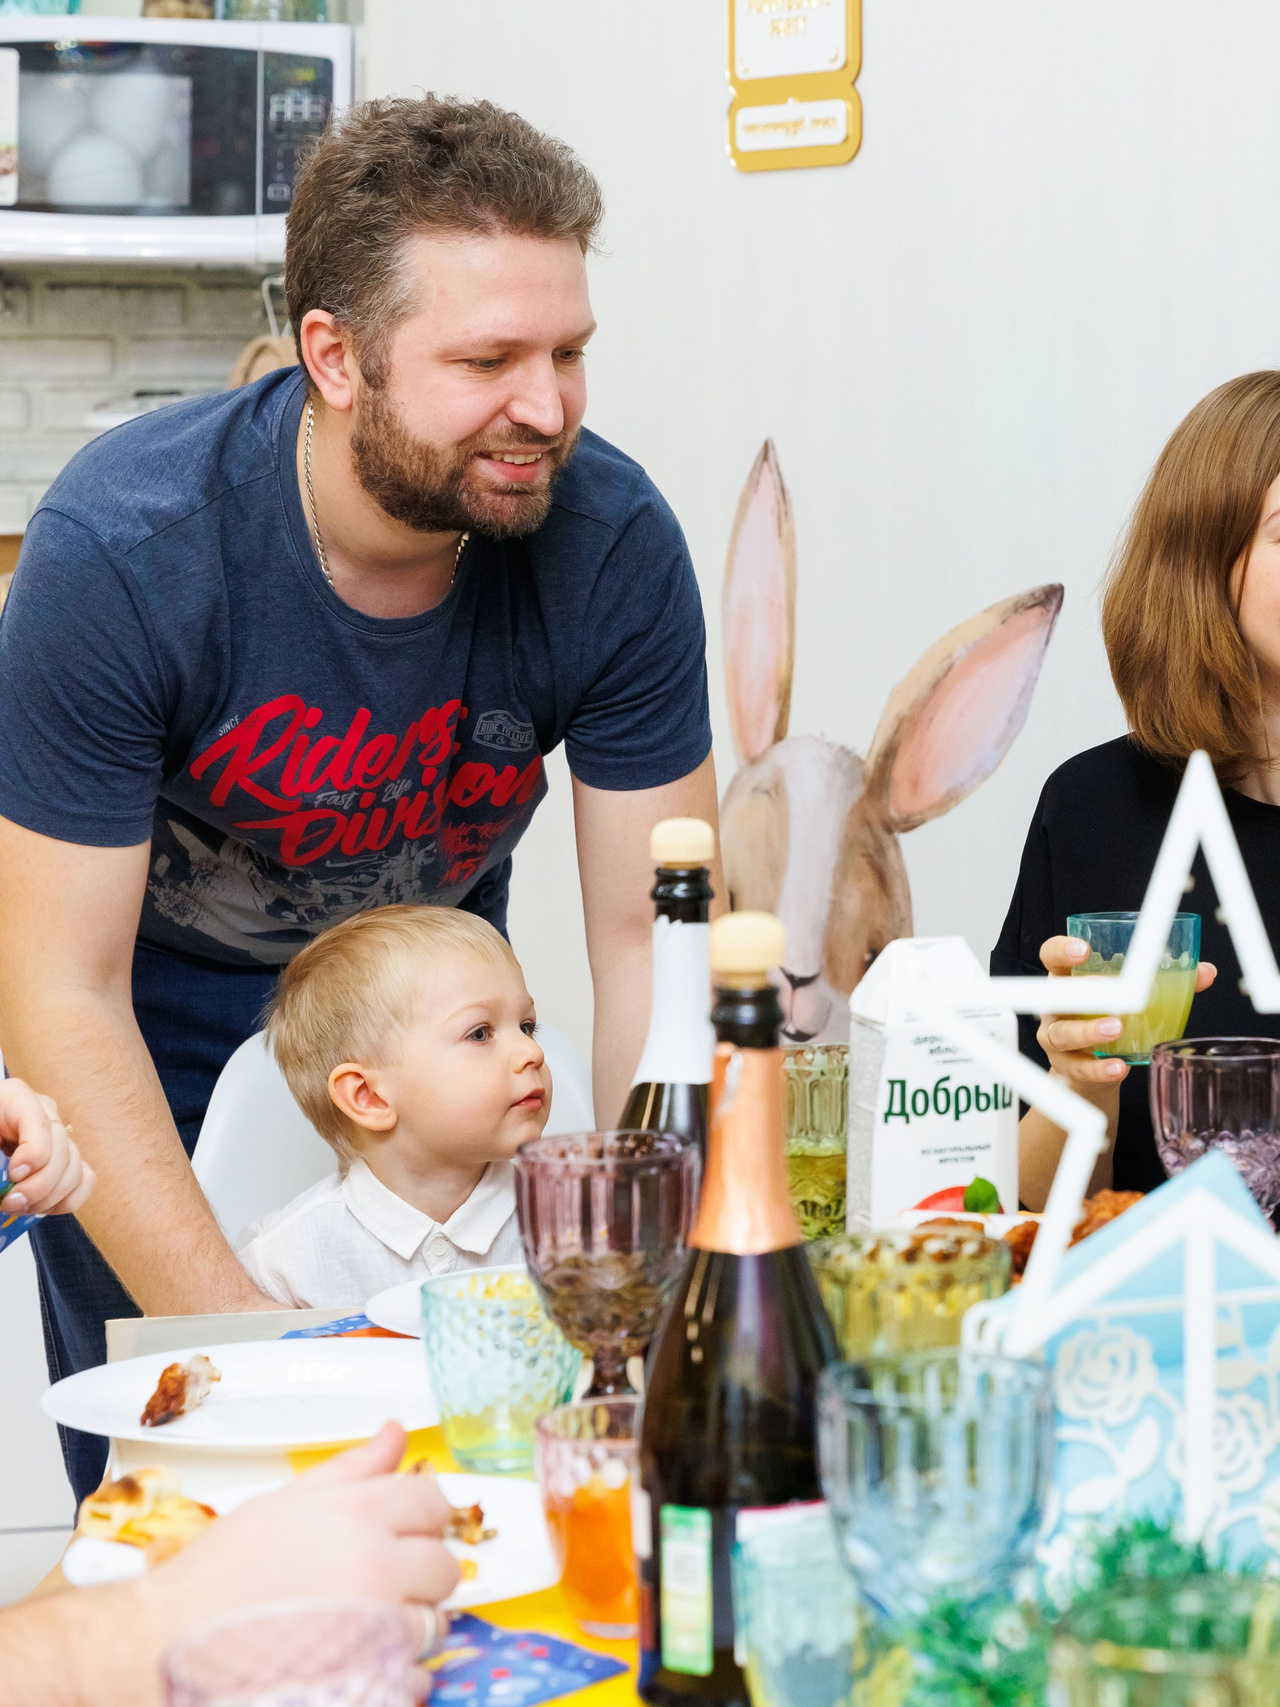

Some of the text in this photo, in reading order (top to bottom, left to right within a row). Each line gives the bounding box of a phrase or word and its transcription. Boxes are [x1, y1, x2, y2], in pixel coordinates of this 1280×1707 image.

[218, 714, 240, 736] SINCE
[480, 723, 531, 743] RIDE TO LIVE
[189, 694, 469, 812] Riders
[314, 778, 413, 810] Fast Life
